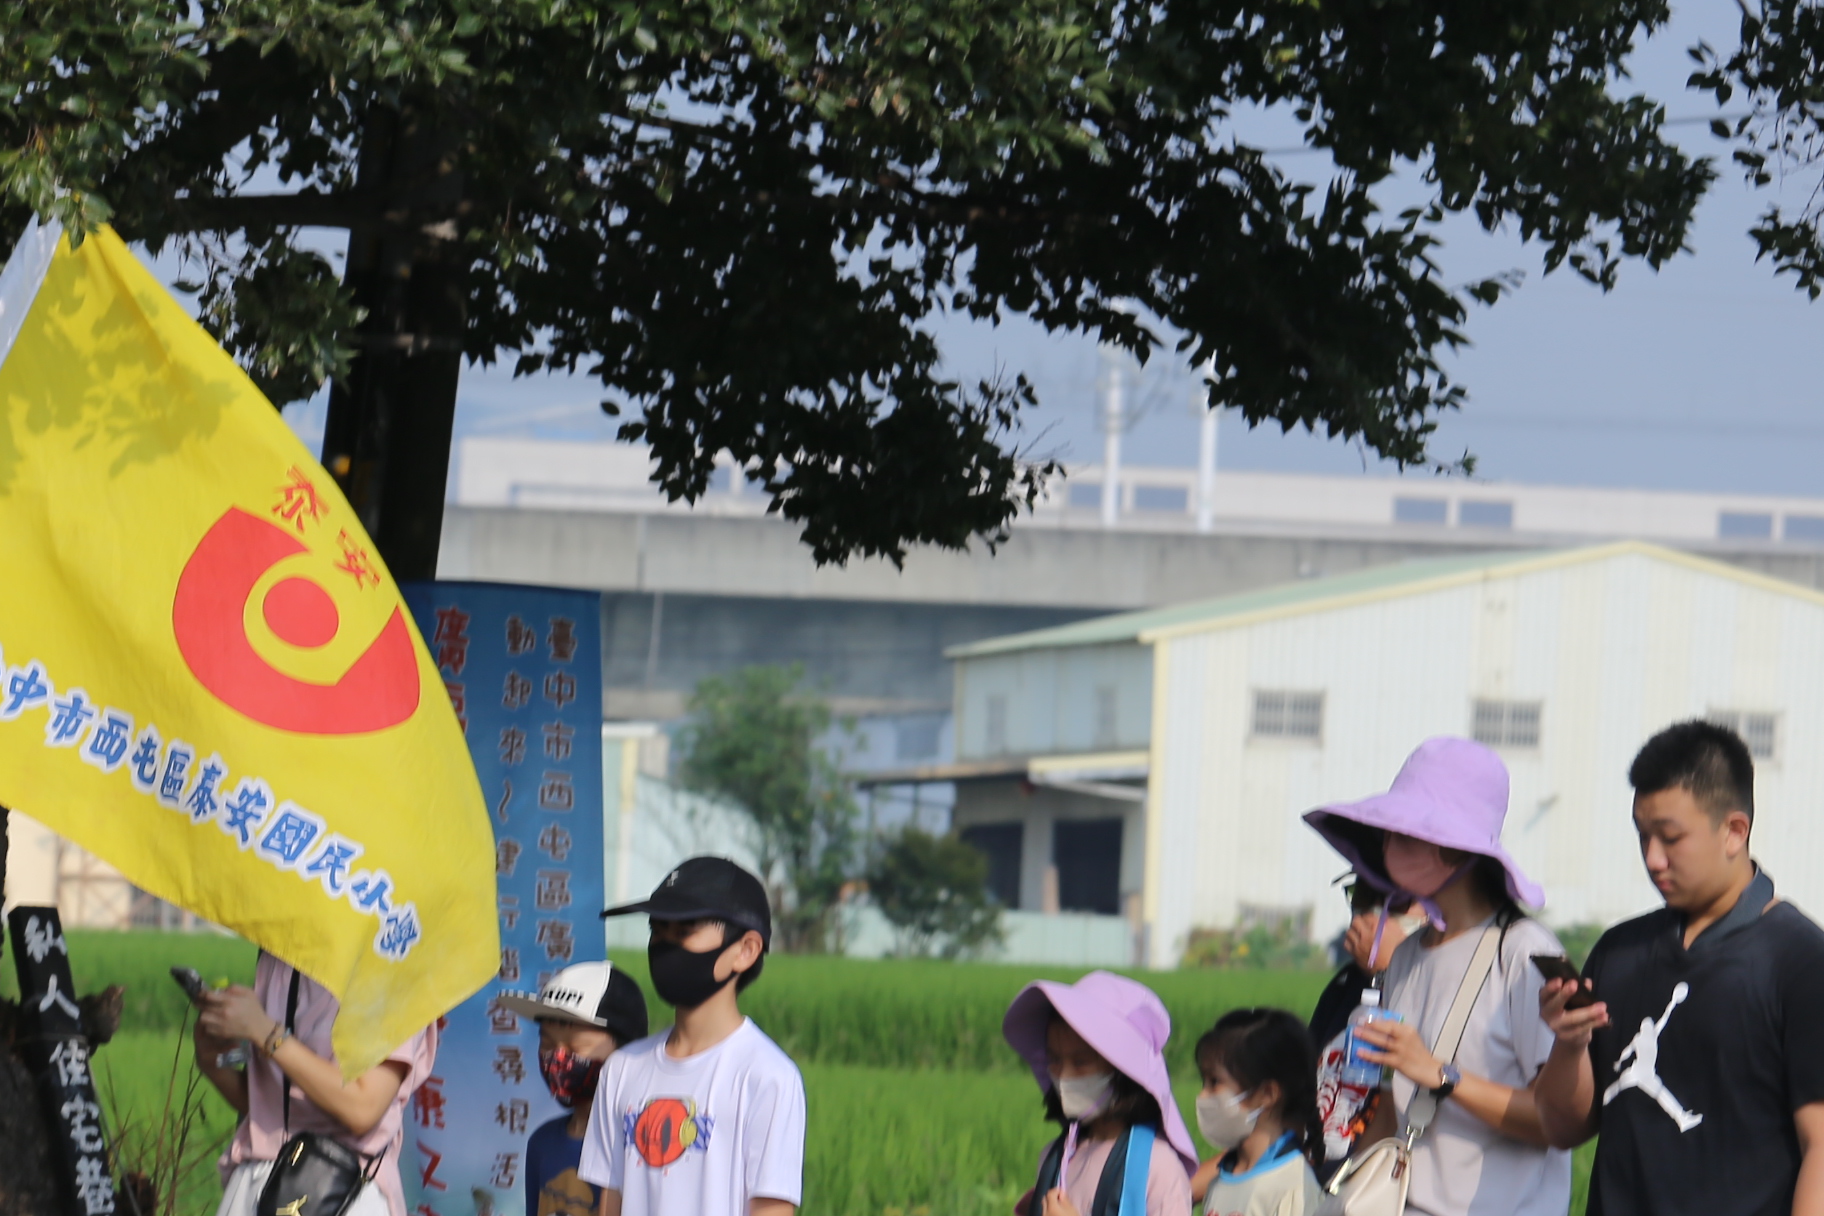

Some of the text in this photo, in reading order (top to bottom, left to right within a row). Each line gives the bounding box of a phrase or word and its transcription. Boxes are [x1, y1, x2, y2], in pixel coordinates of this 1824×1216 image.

[271, 464, 381, 592] 泰安
[534, 616, 577, 1000] 臺中市西屯區廣
